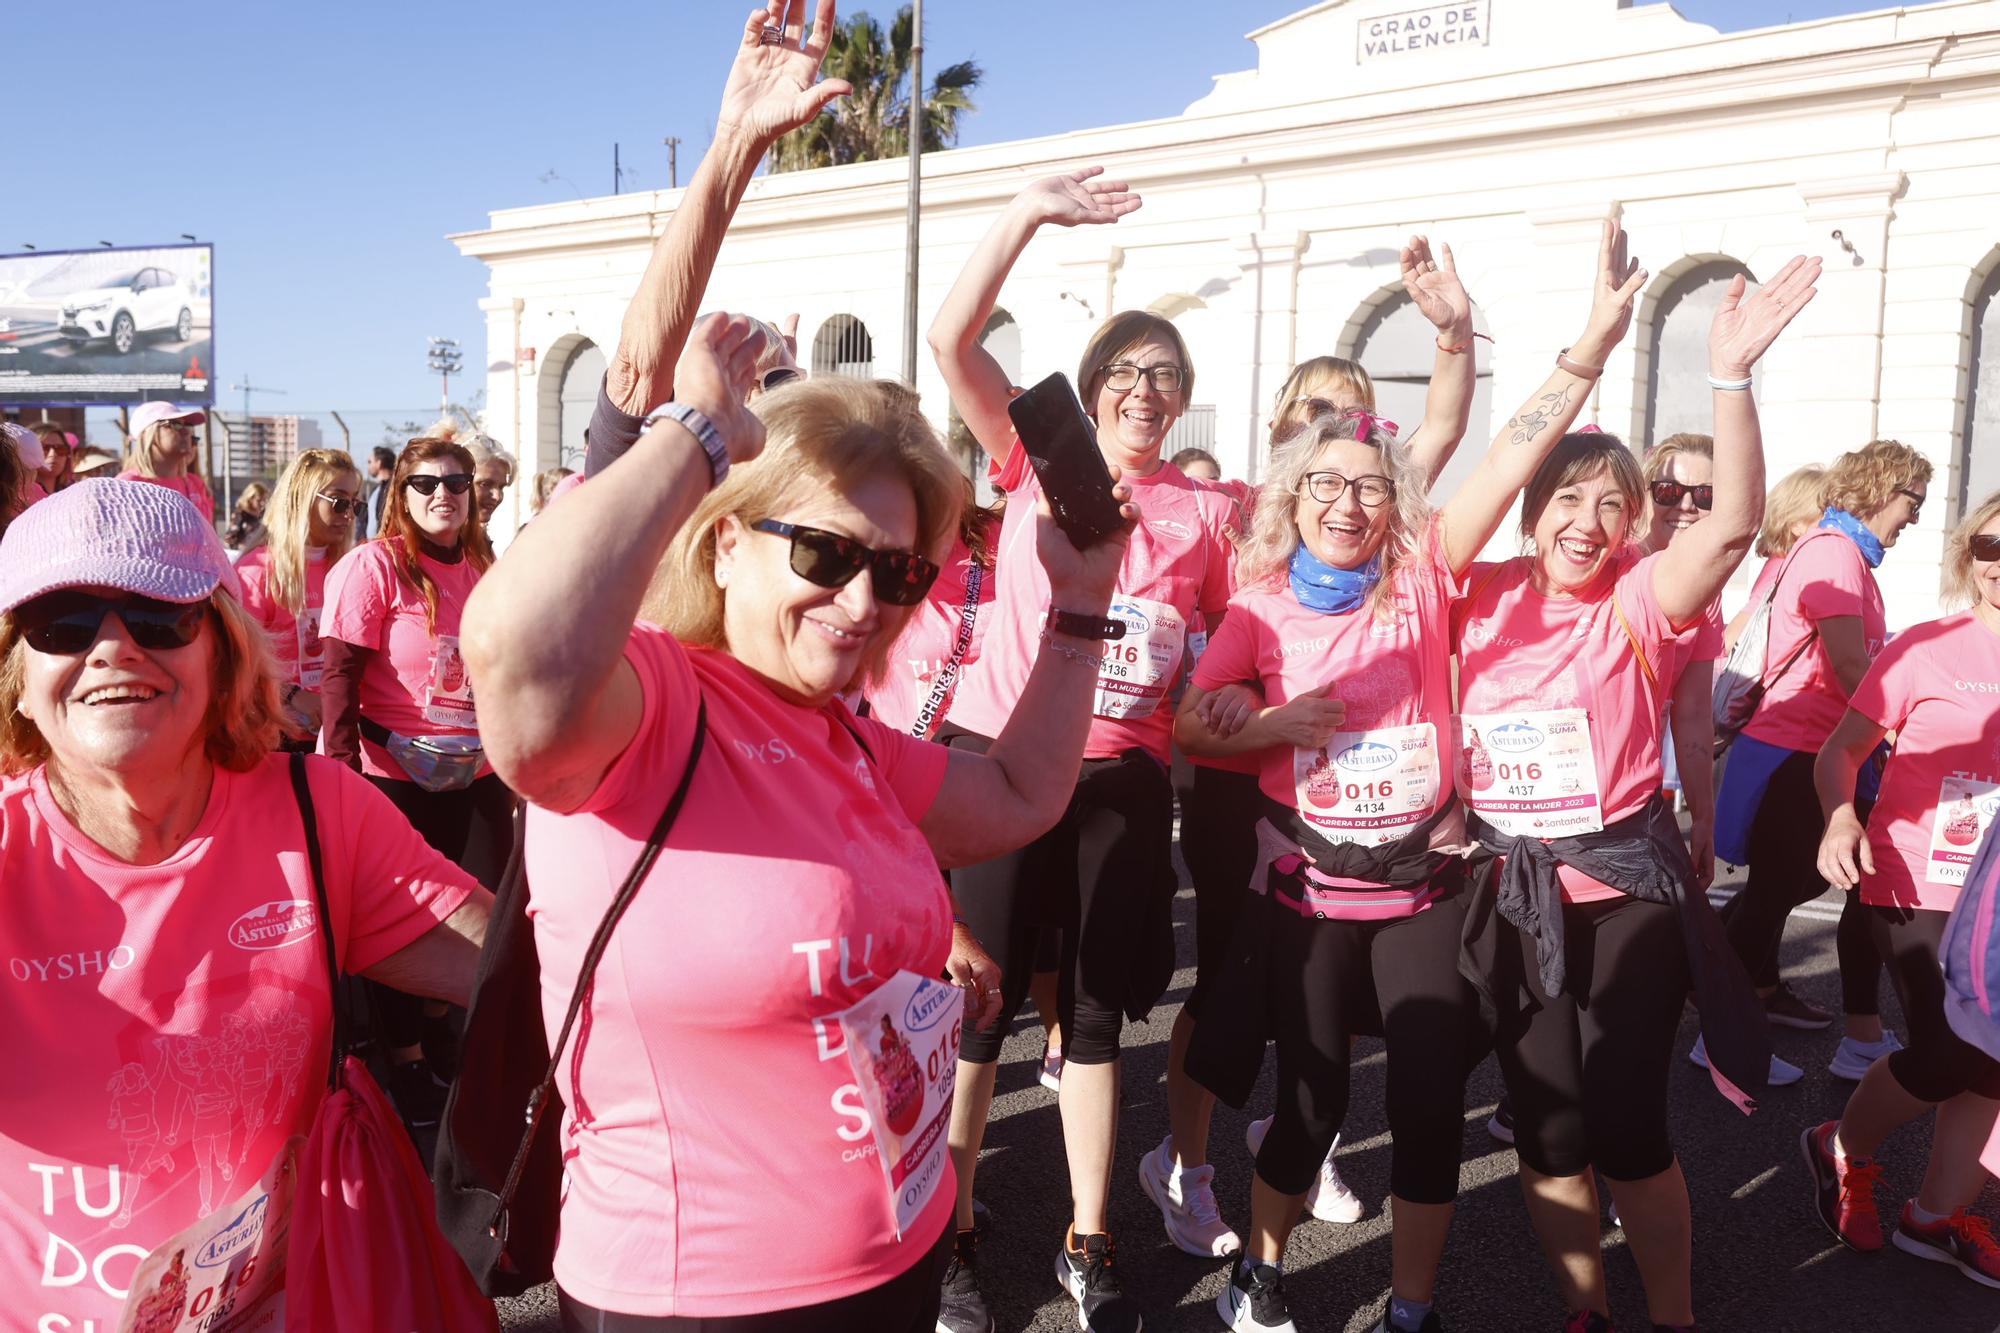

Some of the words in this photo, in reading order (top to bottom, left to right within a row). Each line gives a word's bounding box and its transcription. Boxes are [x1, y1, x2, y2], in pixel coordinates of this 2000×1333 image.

[1370, 15, 1431, 37] GRAO
[1445, 7, 1477, 25] DE
[1365, 26, 1480, 56] VALENCIA
[1155, 619, 1176, 630] SUMA
[1471, 627, 1524, 648] OYSHO
[1273, 638, 1329, 660] OYSHO
[1108, 682, 1120, 690] LA
[1119, 685, 1144, 695] MUJER
[1549, 726, 1578, 735] SUMA
[1401, 741, 1428, 751] SUMA
[1491, 735, 1540, 746] ASTURIANA
[1341, 753, 1394, 766] ASTURIANA
[1498, 763, 1542, 780] 016
[1345, 780, 1393, 799] 016
[1508, 785, 1534, 796] 4137
[1354, 802, 1385, 813] 4134
[1532, 801, 1562, 810] MUJER
[1564, 798, 1585, 807] 2023
[1315, 817, 1353, 828] CARRERA
[1380, 816, 1407, 826] MUJER
[1544, 815, 1590, 828] Santander
[10, 945, 136, 982] OYSHO
[792, 933, 874, 997] TU
[928, 1018, 960, 1082] 016
[905, 1151, 941, 1207] OYSHO
[28, 1163, 122, 1217] TU
[189, 1254, 258, 1318] 016
[196, 1297, 236, 1333] 1093
